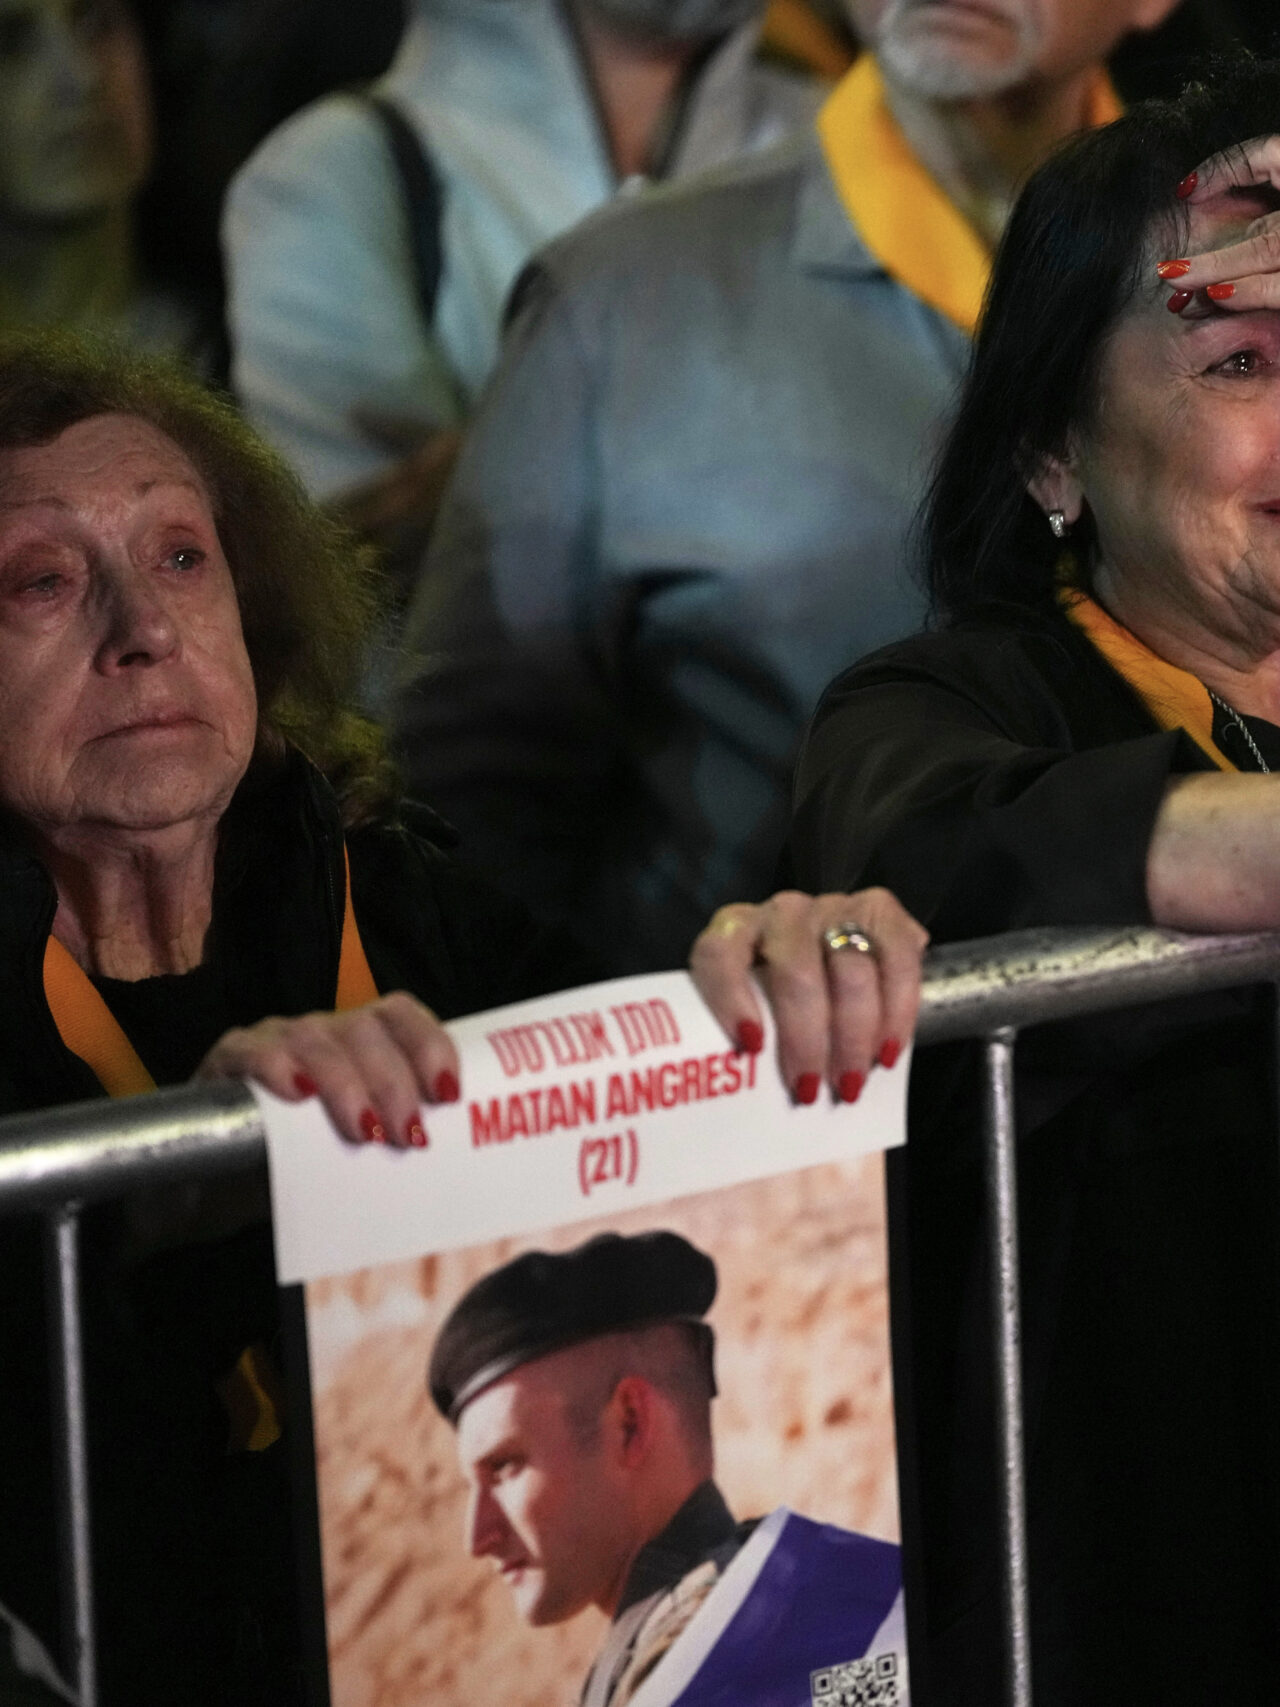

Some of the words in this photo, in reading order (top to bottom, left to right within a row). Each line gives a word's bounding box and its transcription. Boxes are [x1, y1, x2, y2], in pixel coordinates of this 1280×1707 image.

[468, 1078, 597, 1147] MATAN
[606, 1048, 757, 1120] ANGREST
[577, 1127, 639, 1197] (21)
